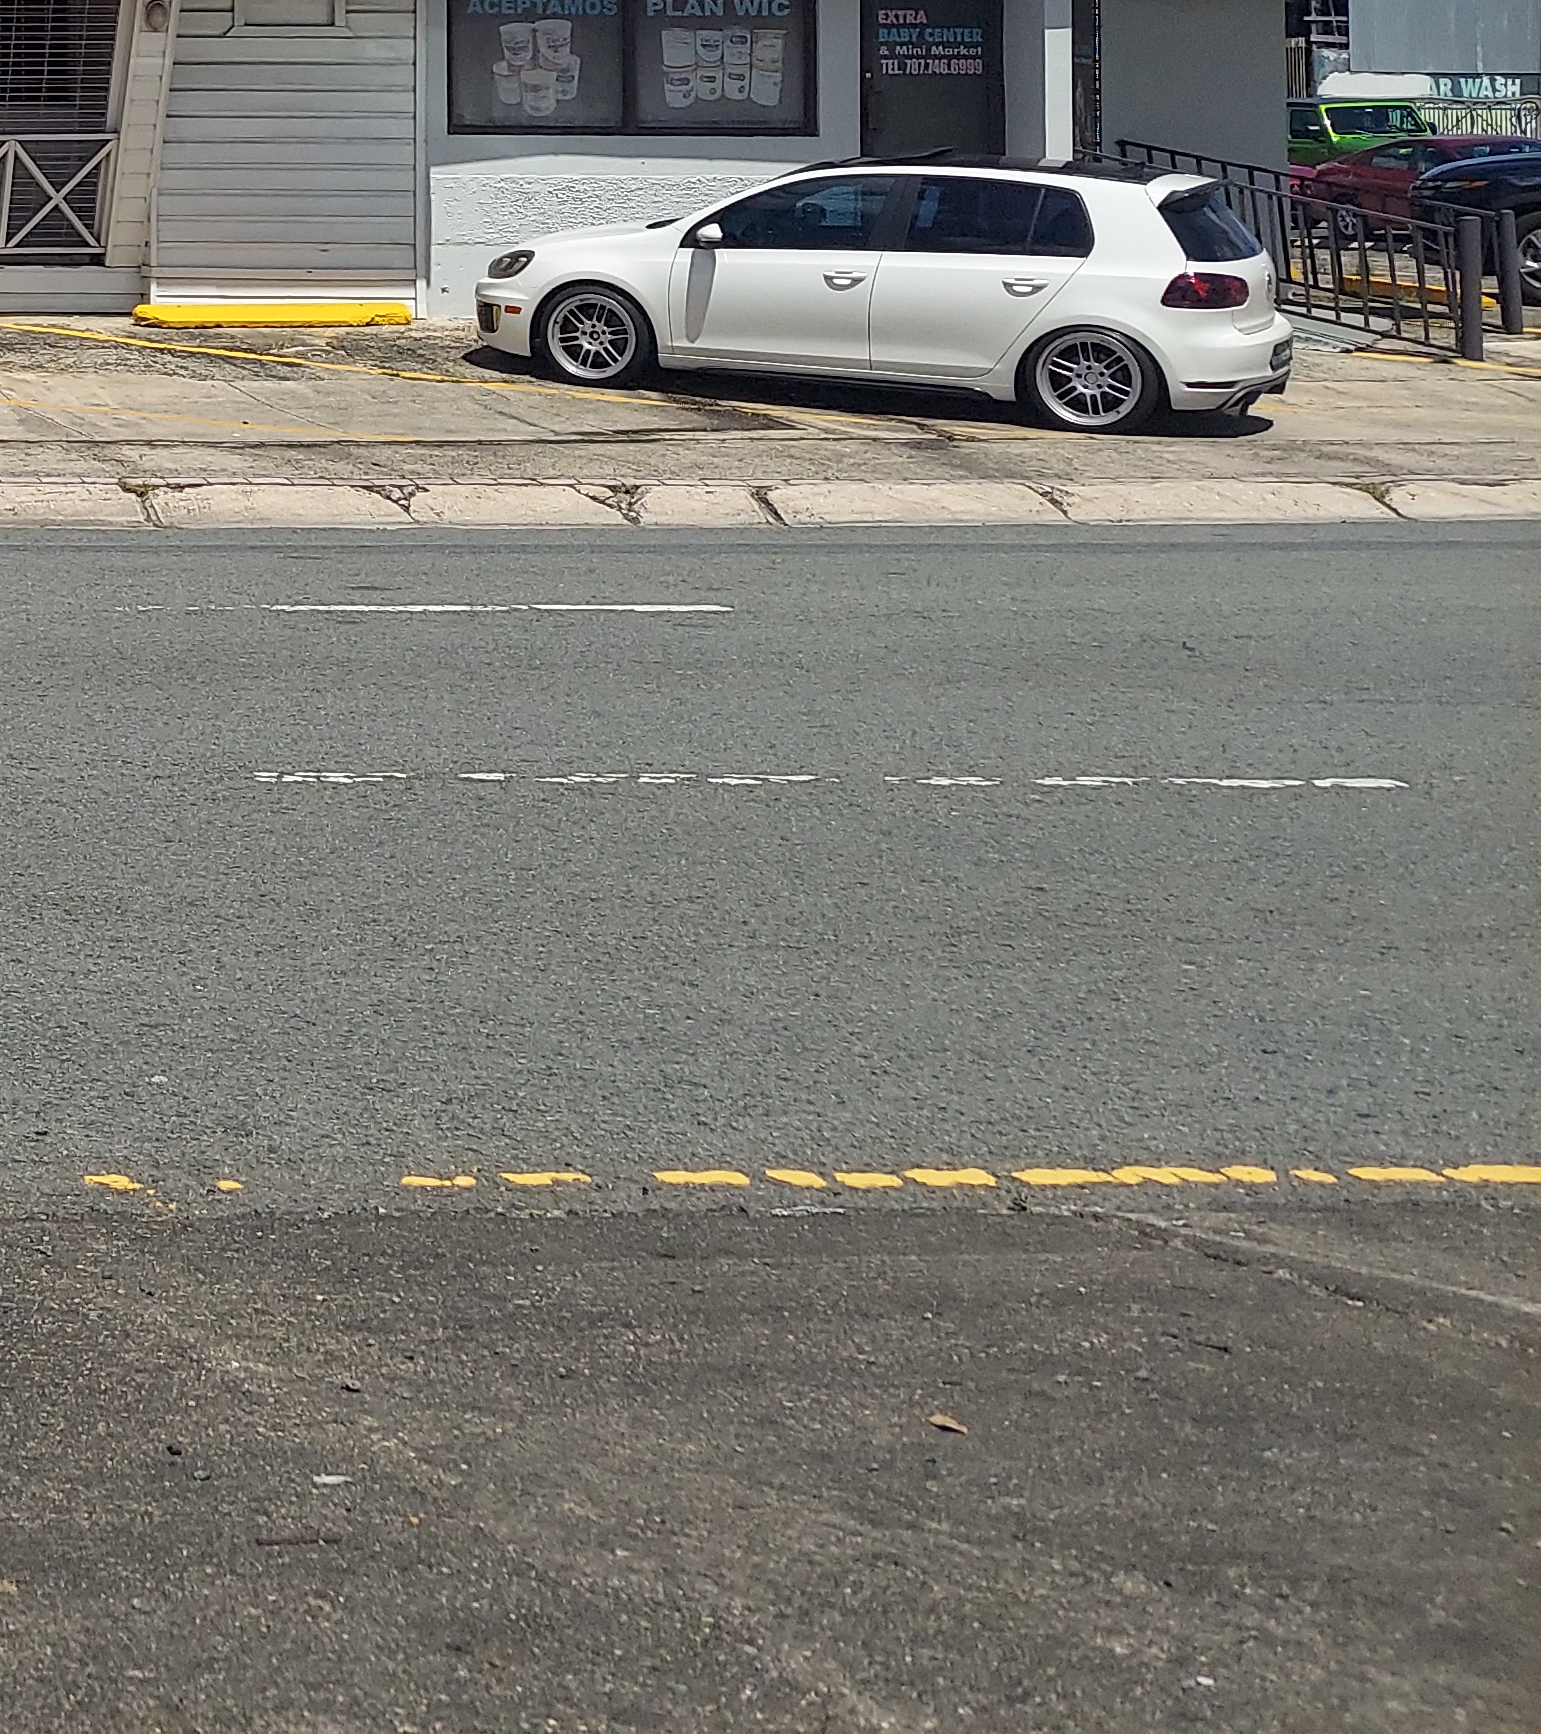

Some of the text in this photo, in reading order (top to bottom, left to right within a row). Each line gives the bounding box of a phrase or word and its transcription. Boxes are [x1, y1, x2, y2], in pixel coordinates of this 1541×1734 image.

[878, 9, 927, 24] EXTRA
[878, 28, 982, 42] BABY CENTER
[879, 45, 982, 55] & Mini Market
[904, 58, 982, 75] 787.746.6999
[1428, 75, 1521, 98] AR WASH
